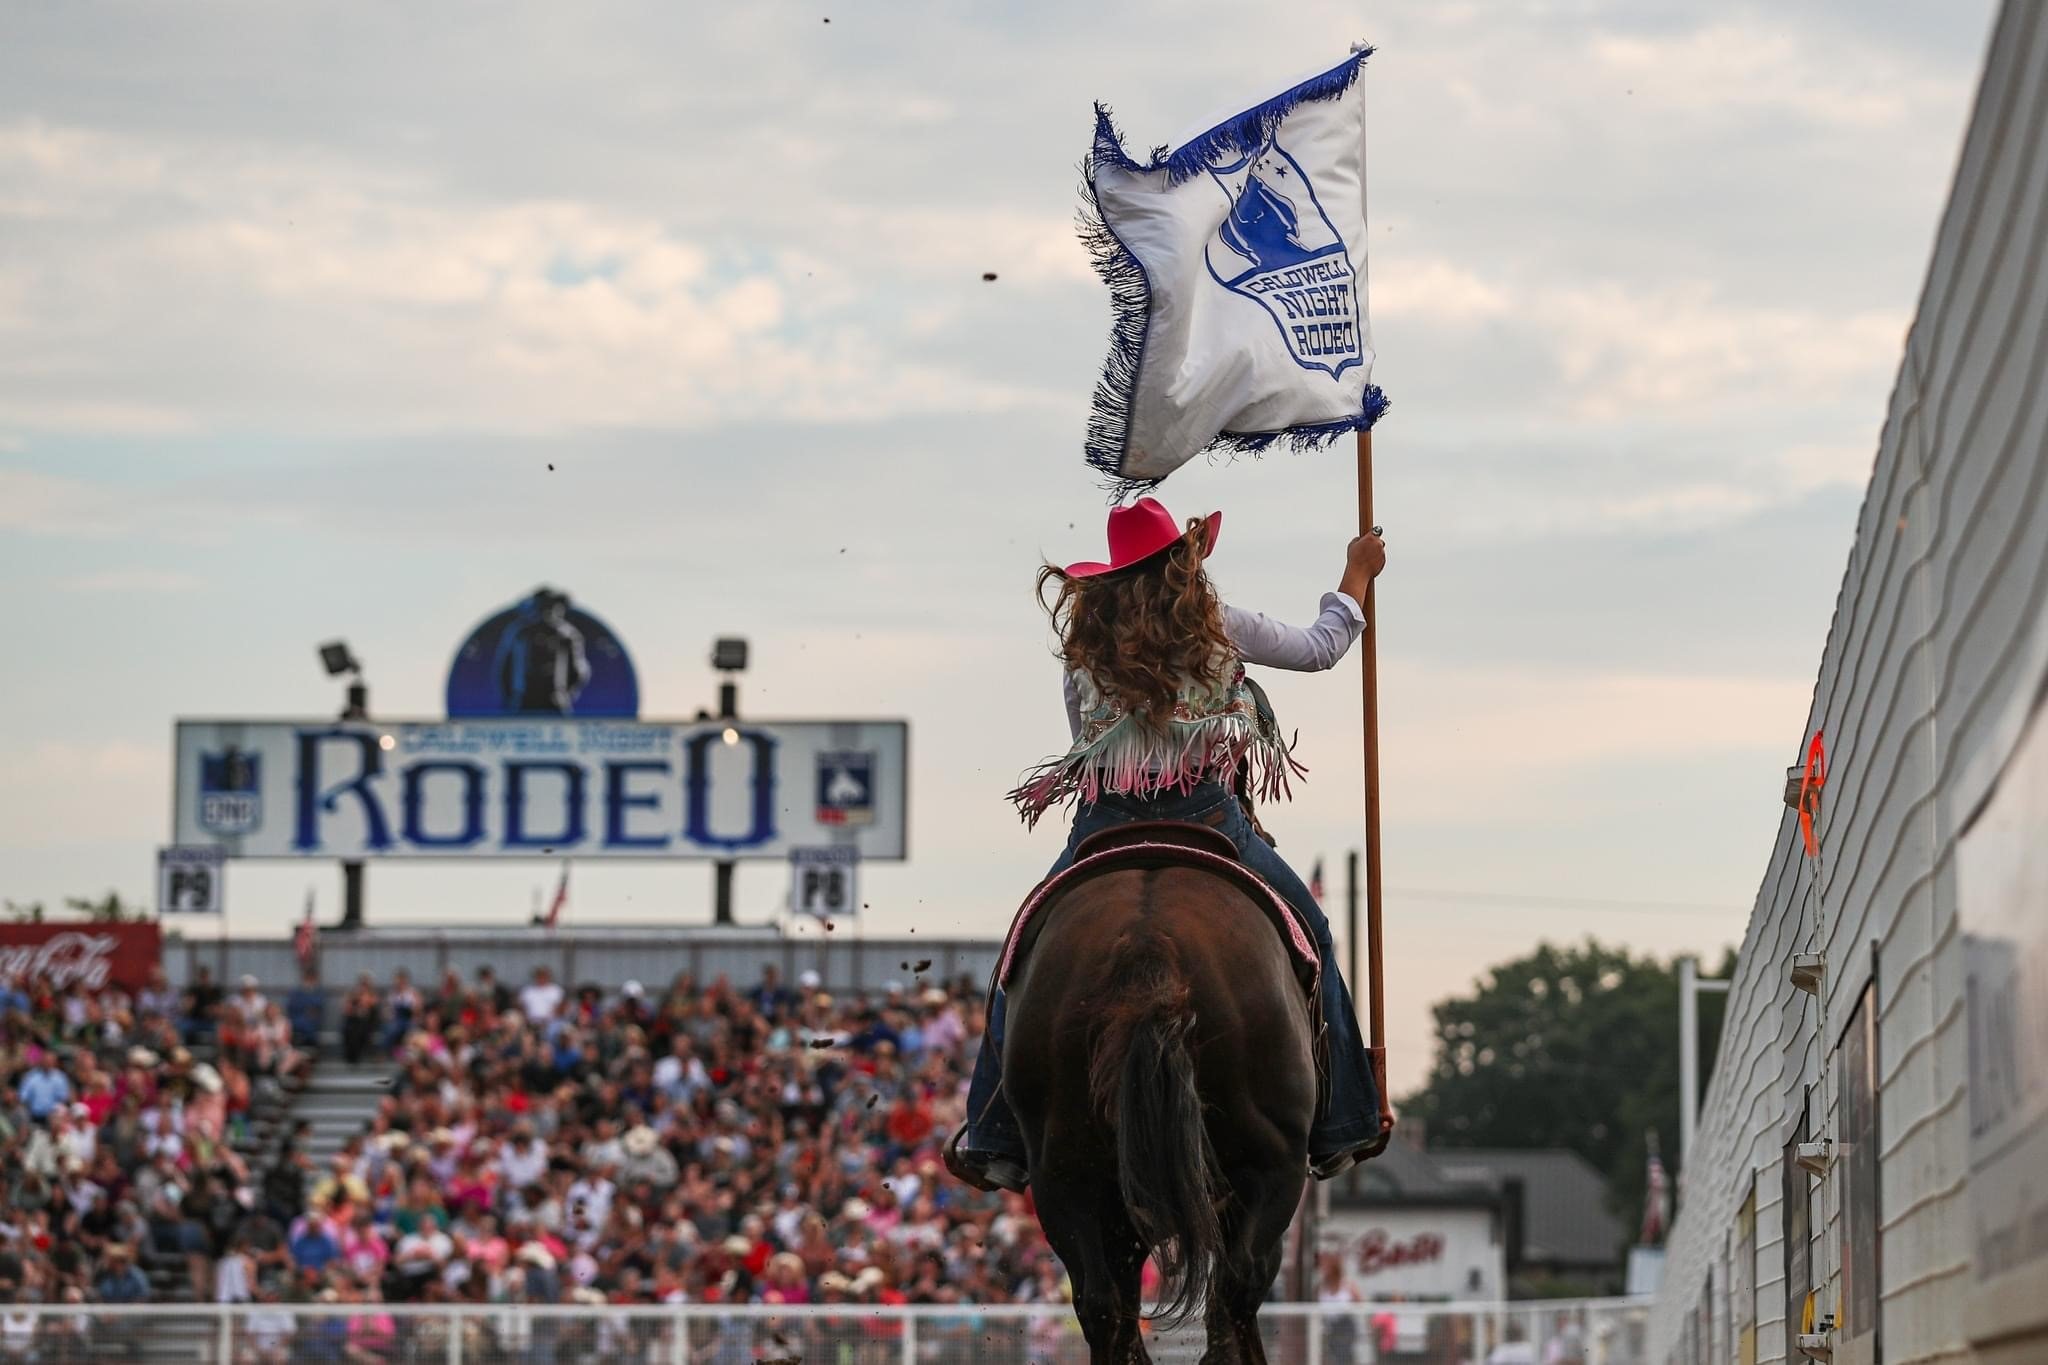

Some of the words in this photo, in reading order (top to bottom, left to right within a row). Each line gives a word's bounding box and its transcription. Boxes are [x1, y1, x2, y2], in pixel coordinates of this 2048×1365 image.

[1245, 260, 1350, 294] CALDWELL
[1273, 284, 1349, 319] NIGHT
[1291, 322, 1356, 356] RODEO
[292, 728, 779, 853] RODEO
